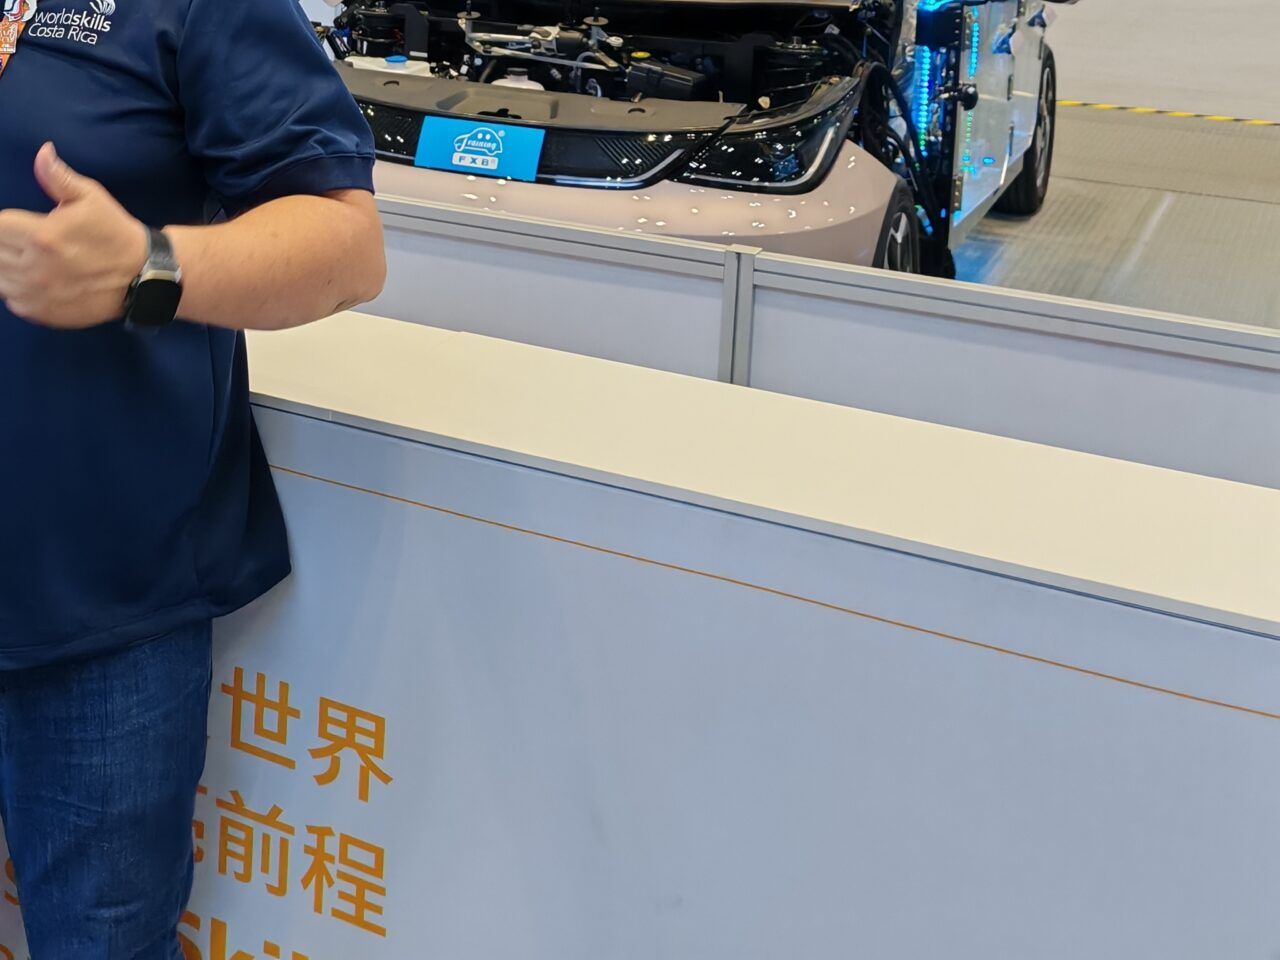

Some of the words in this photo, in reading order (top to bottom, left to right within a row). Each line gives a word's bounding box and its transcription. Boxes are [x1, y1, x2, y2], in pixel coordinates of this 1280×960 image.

[28, 22, 66, 39] Costa
[67, 25, 98, 46] Rica
[35, 7, 112, 33] worldskills
[221, 666, 394, 803] 世界
[194, 784, 387, 938] 前程
